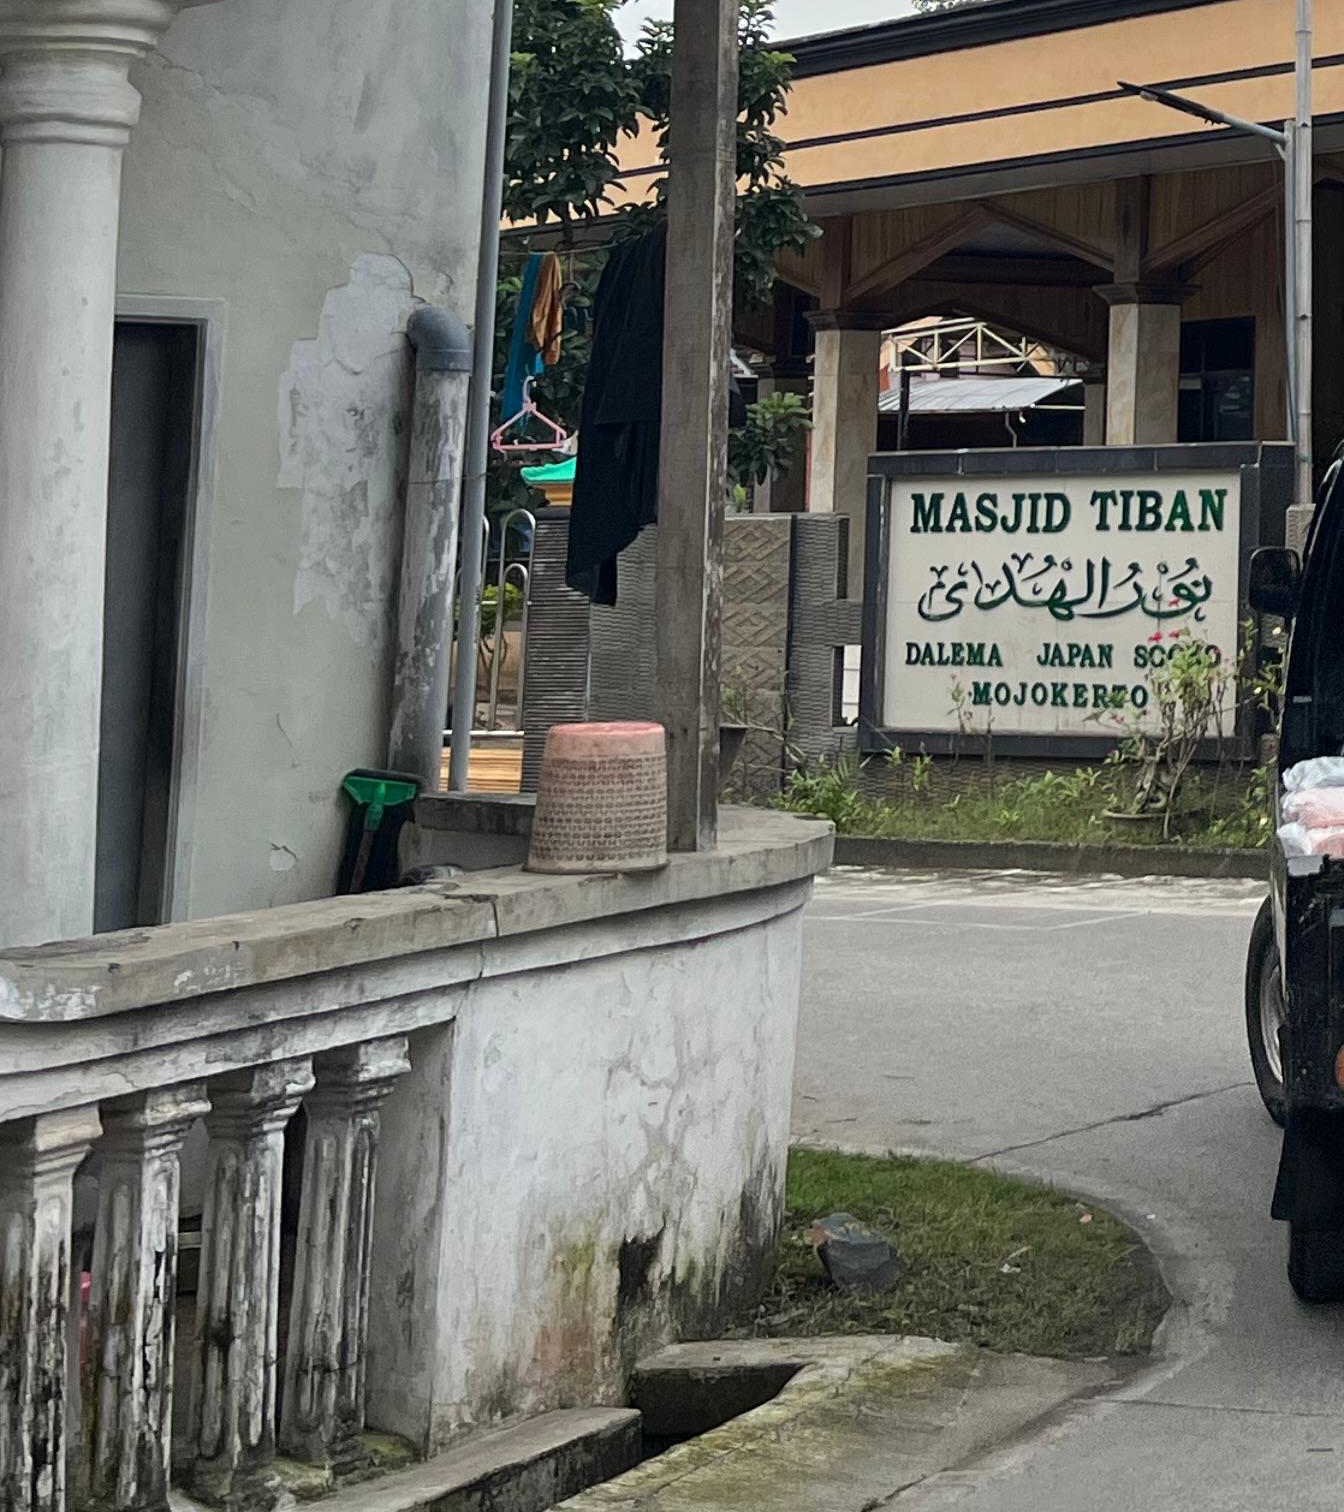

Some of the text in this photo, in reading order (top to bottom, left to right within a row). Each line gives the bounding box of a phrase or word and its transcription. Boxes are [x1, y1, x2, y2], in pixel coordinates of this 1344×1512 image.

[911, 489, 1228, 534] MASJID TIBAN
[905, 642, 1004, 667] DALEMA
[1037, 642, 1114, 668] JAPAN
[972, 681, 1148, 709] MOJOKERTO
